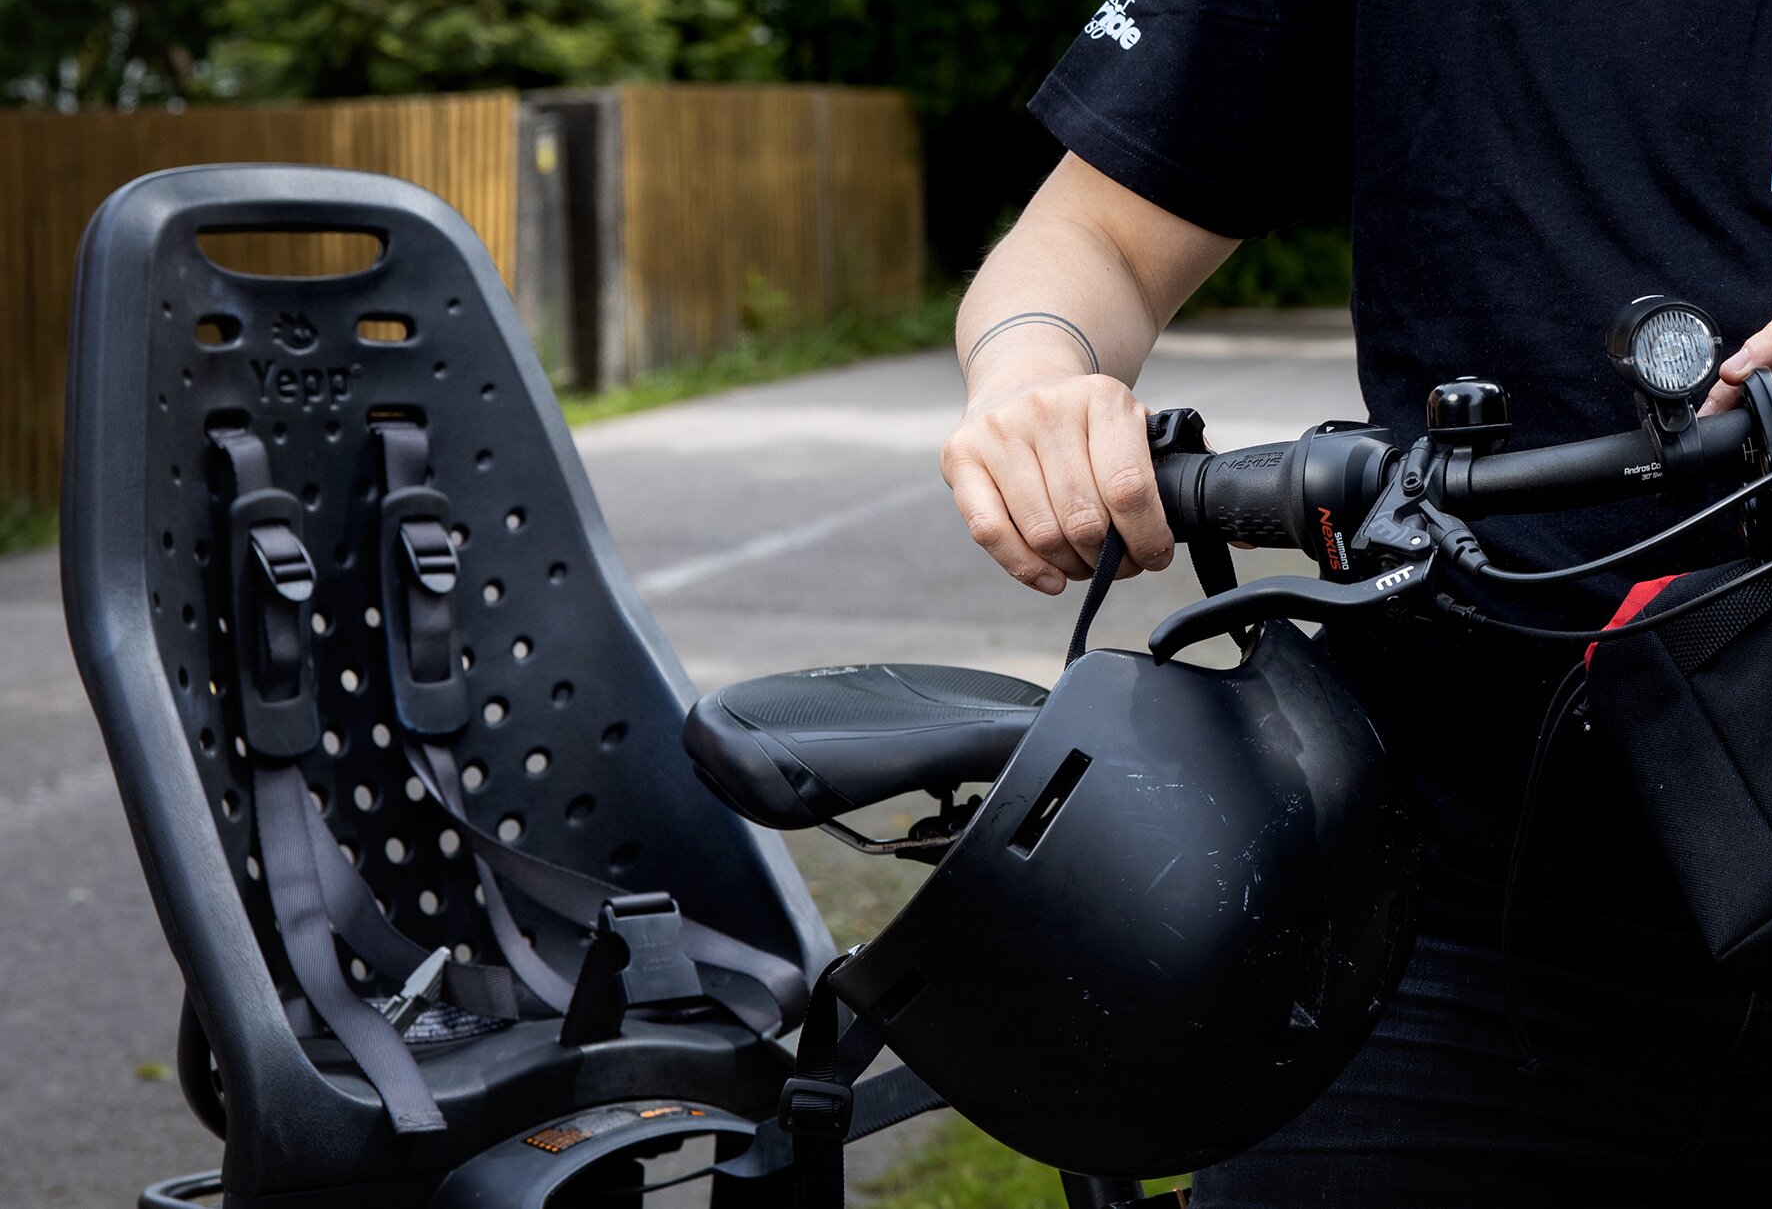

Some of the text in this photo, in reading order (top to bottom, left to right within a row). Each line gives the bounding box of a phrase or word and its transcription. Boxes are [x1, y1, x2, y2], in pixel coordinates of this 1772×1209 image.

[1092, 1, 1141, 50] ride
[250, 359, 353, 412] Yepp
[1624, 465, 1651, 475] Andros
[1334, 532, 1349, 571] SHIMANO
